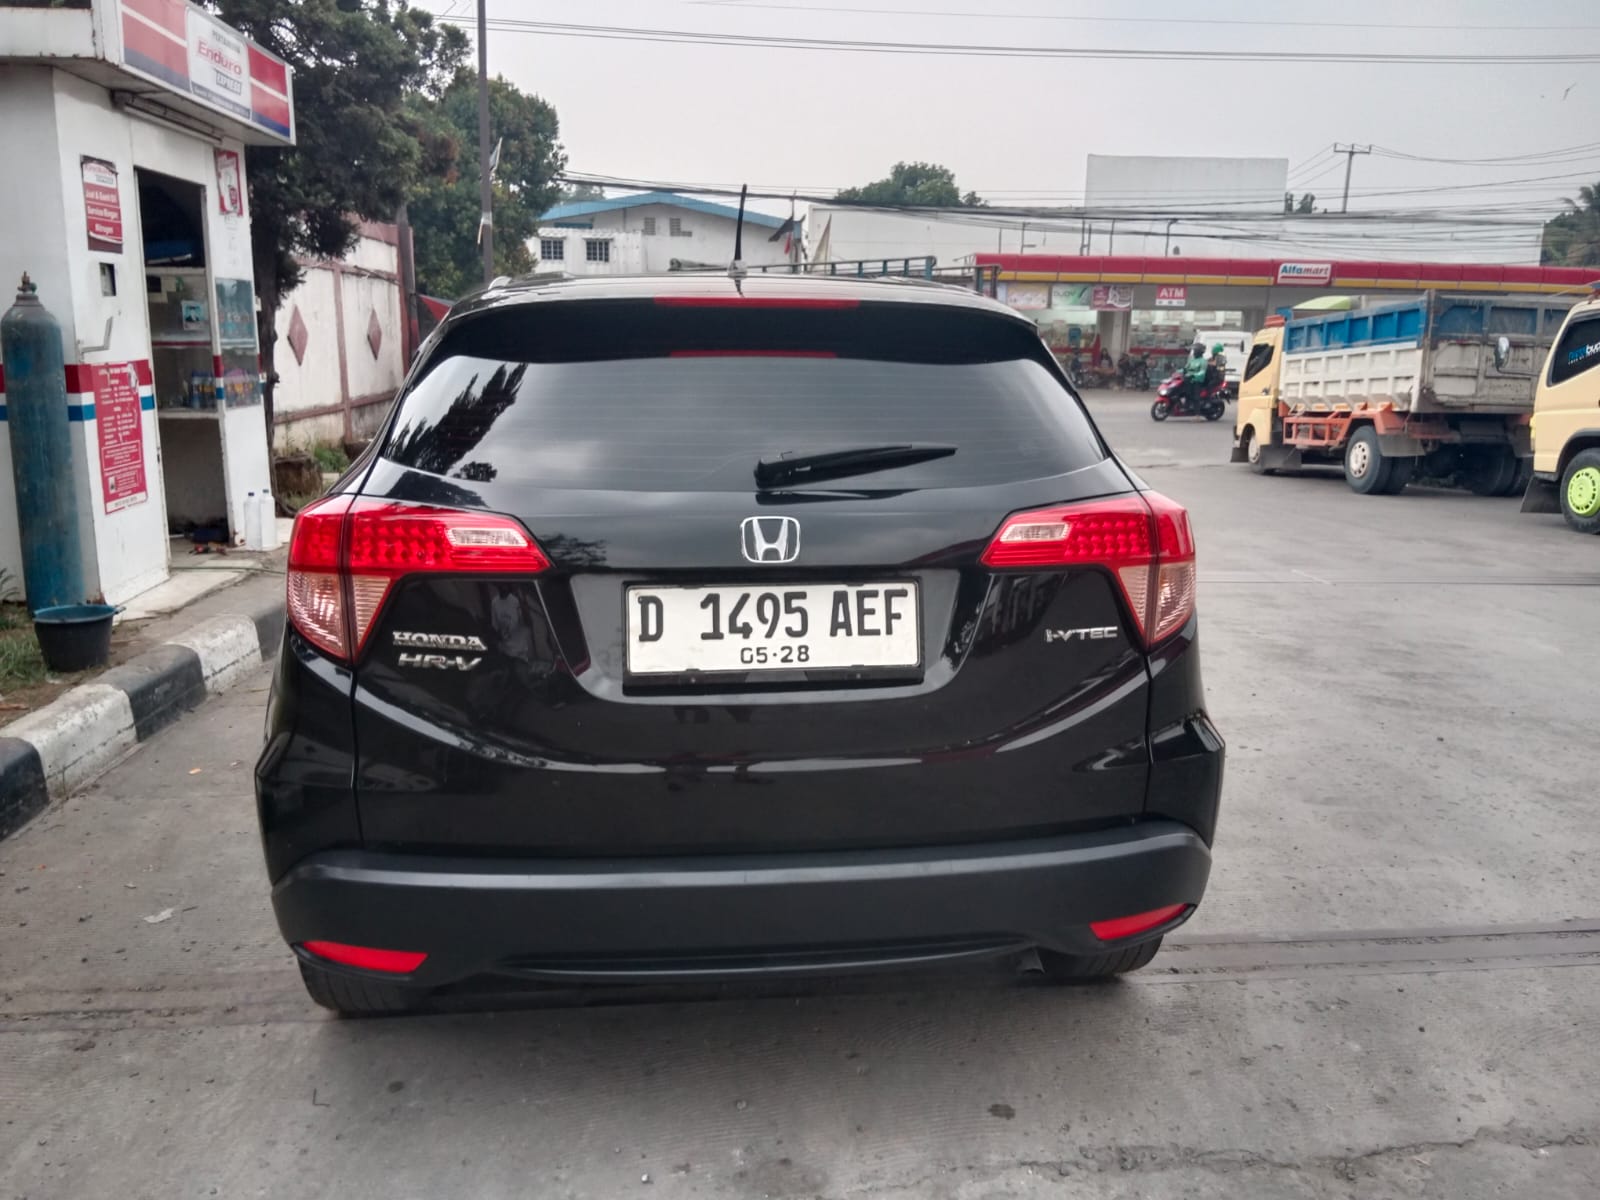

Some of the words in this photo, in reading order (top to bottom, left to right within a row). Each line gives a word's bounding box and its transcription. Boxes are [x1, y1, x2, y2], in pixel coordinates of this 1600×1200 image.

[198, 39, 242, 76] Enduro
[1280, 264, 1329, 275] Alfamart
[1159, 287, 1185, 299] ATM
[638, 595, 664, 642] D
[700, 591, 809, 640] 1495
[829, 589, 909, 637] AEF
[392, 631, 487, 651] HONDA
[398, 653, 482, 671] HR-V
